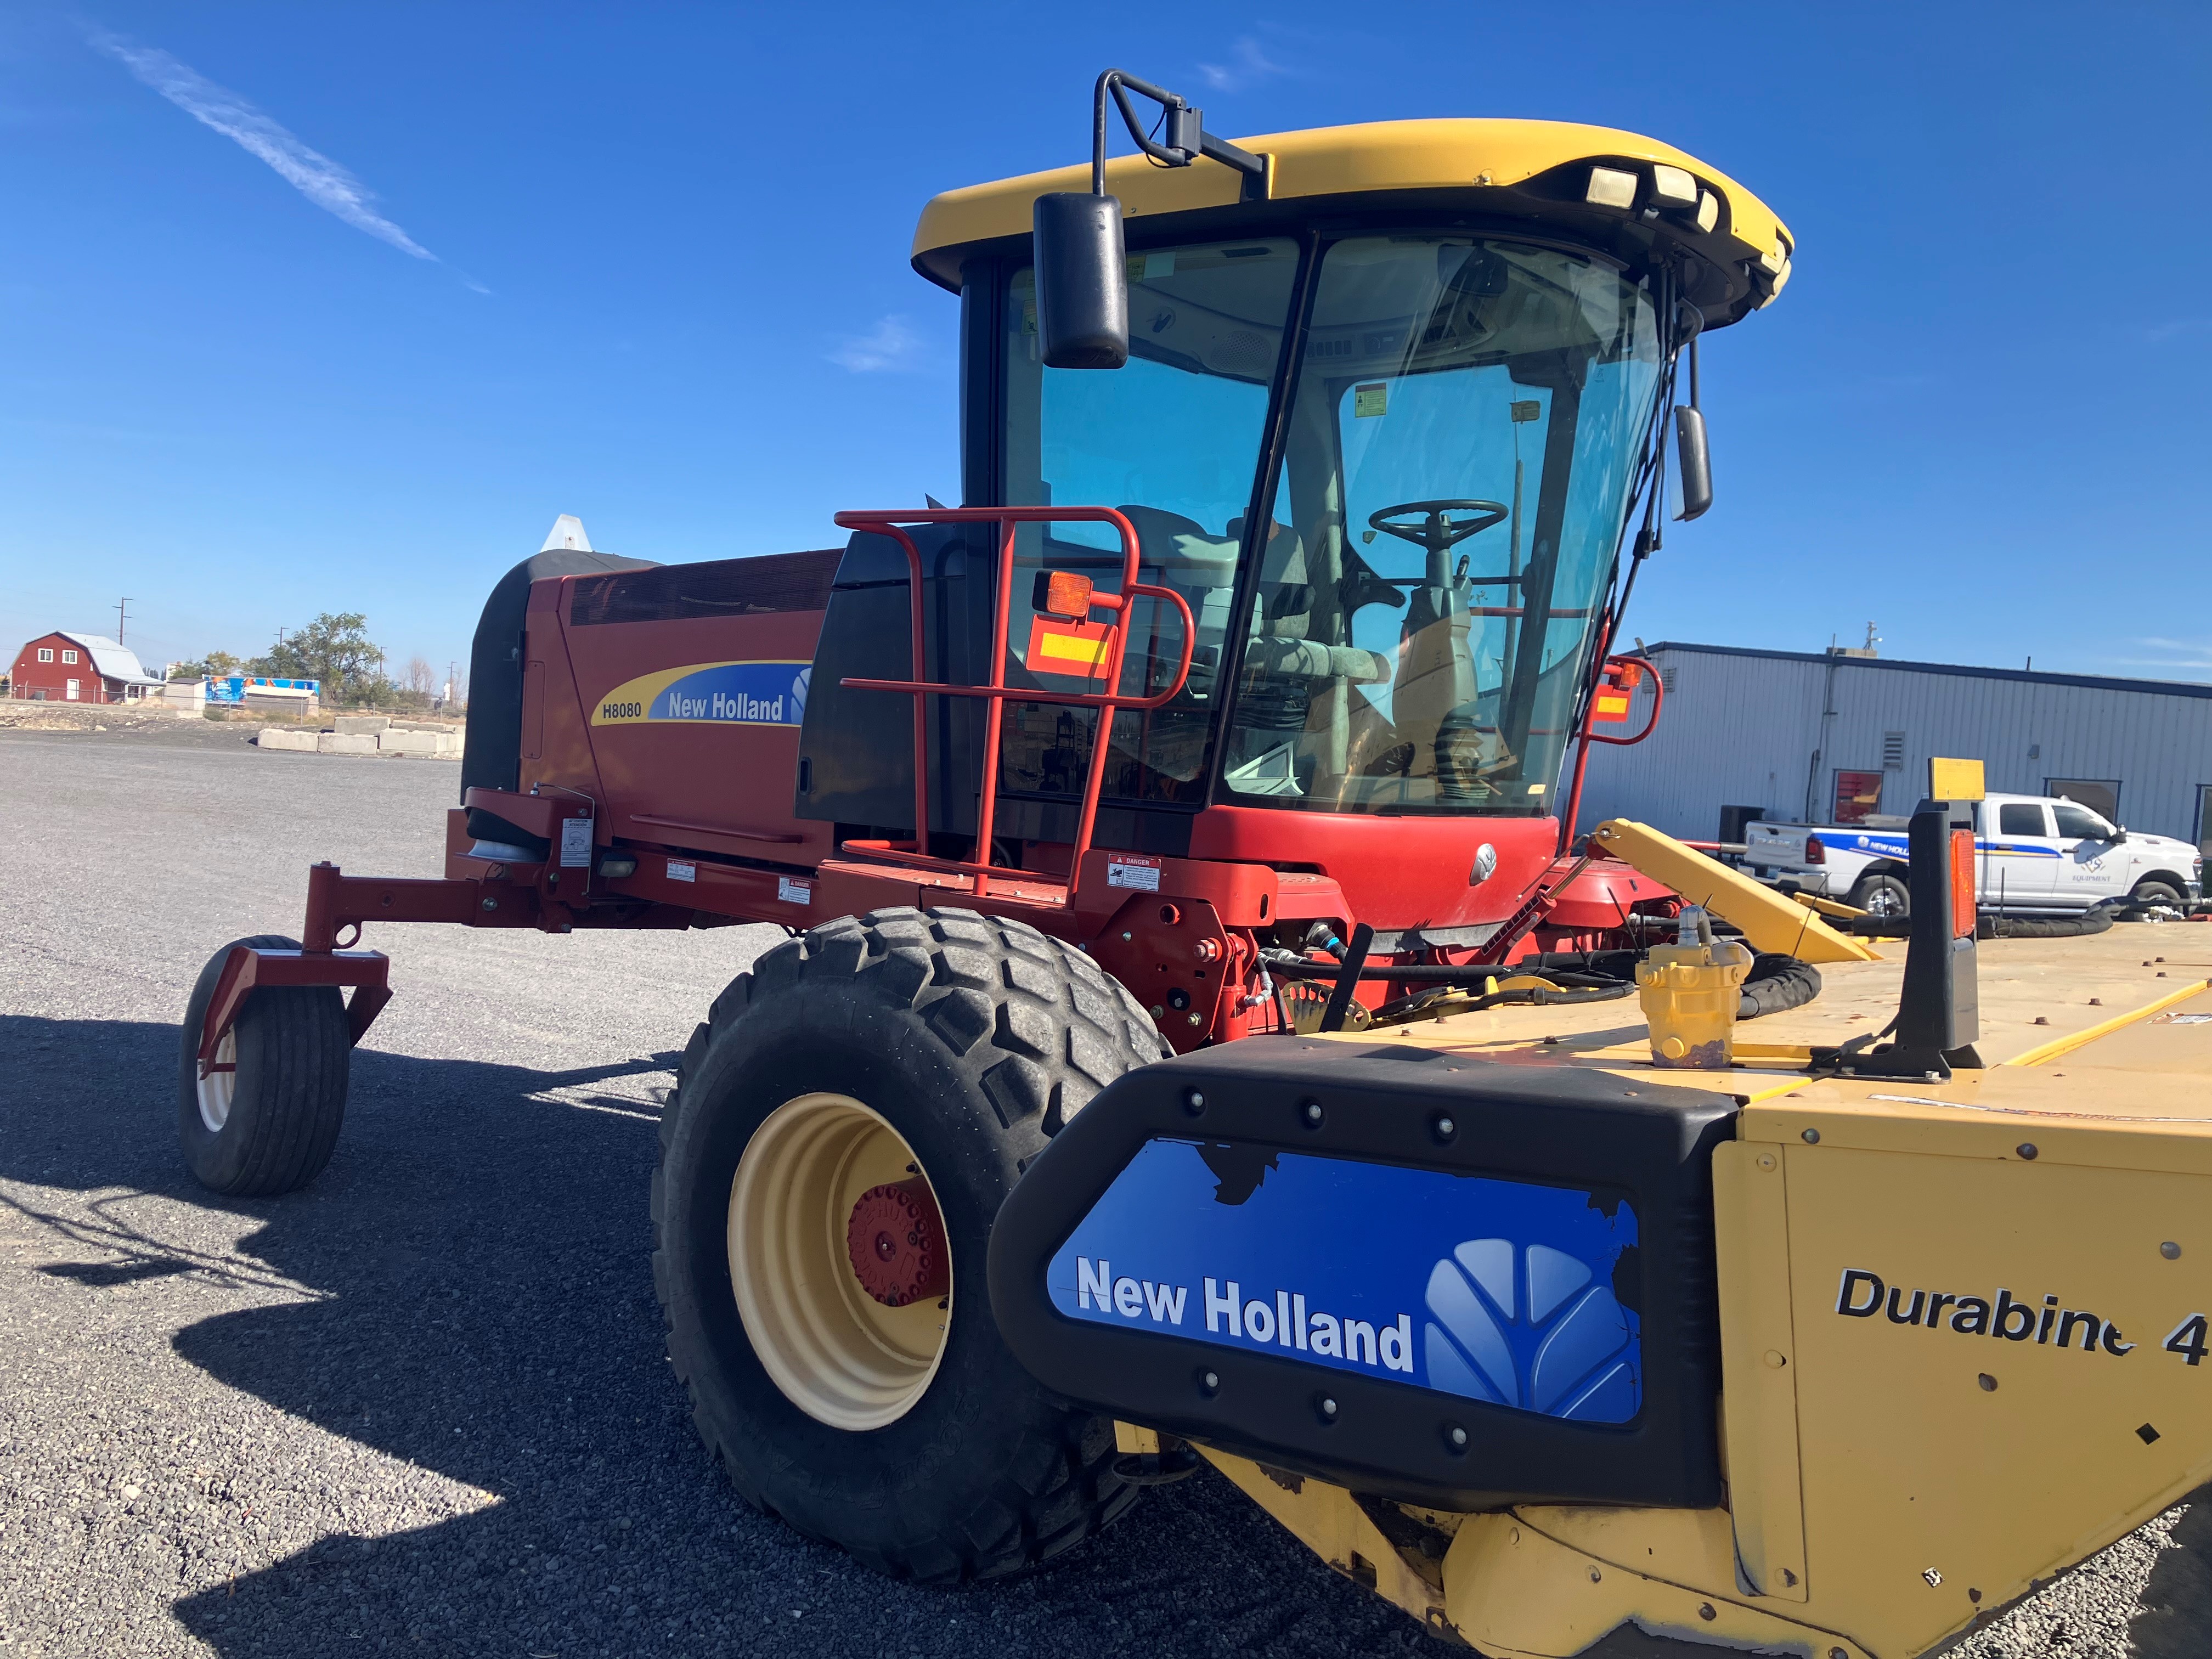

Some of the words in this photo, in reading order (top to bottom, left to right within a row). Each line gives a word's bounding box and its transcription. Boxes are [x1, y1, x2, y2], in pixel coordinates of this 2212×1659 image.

[603, 702, 641, 719] H8080
[668, 692, 707, 718] New
[713, 692, 783, 721] Holland
[1870, 842, 1888, 851] NEW
[1126, 857, 1149, 866] DANGER
[1076, 1255, 1188, 1325] New
[1203, 1276, 1414, 1373] Holland
